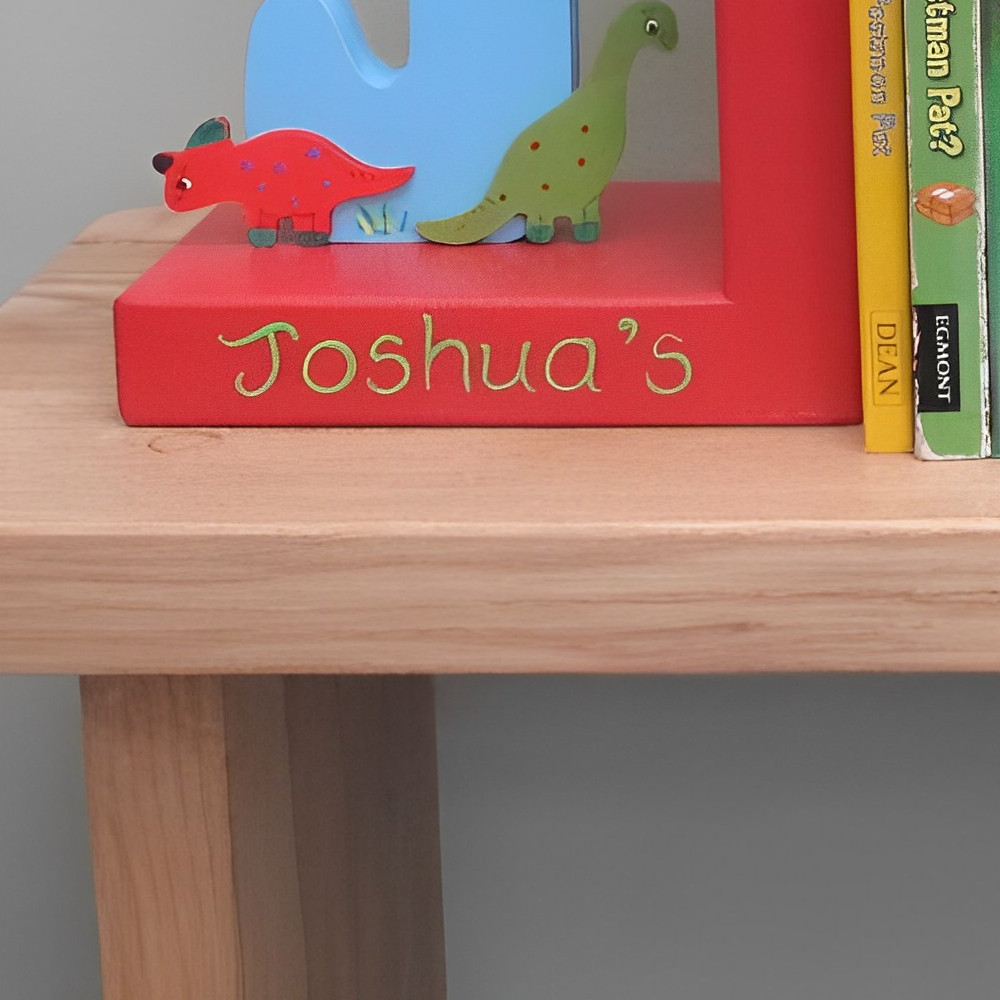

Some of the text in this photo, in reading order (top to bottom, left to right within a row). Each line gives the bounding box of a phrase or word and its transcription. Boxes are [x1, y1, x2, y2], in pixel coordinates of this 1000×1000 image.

[926, 85, 965, 158] Pat?
[218, 313, 692, 397] Joshua's
[876, 323, 899, 396] DEAN
[935, 315, 950, 403] EGMONT
